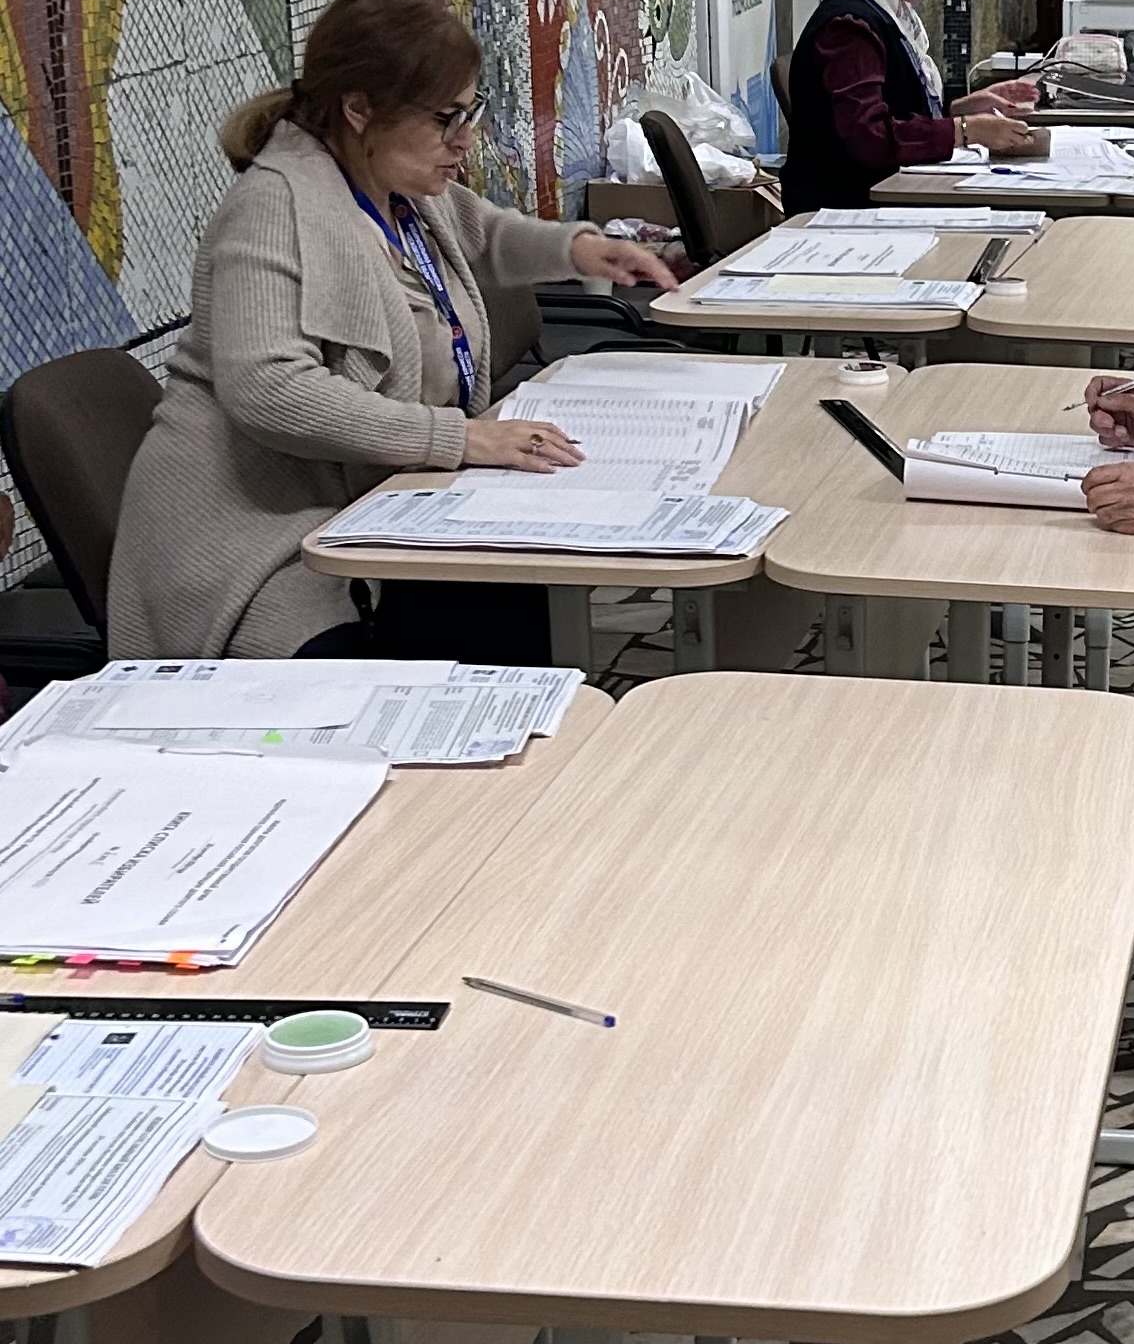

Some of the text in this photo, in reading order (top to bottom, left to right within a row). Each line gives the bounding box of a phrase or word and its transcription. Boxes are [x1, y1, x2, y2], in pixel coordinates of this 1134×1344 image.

[160, 811, 193, 830] КНИГА
[131, 832, 170, 858] СПИСКА
[79, 858, 141, 904] ИЗБИРАТЕЛЕЙ
